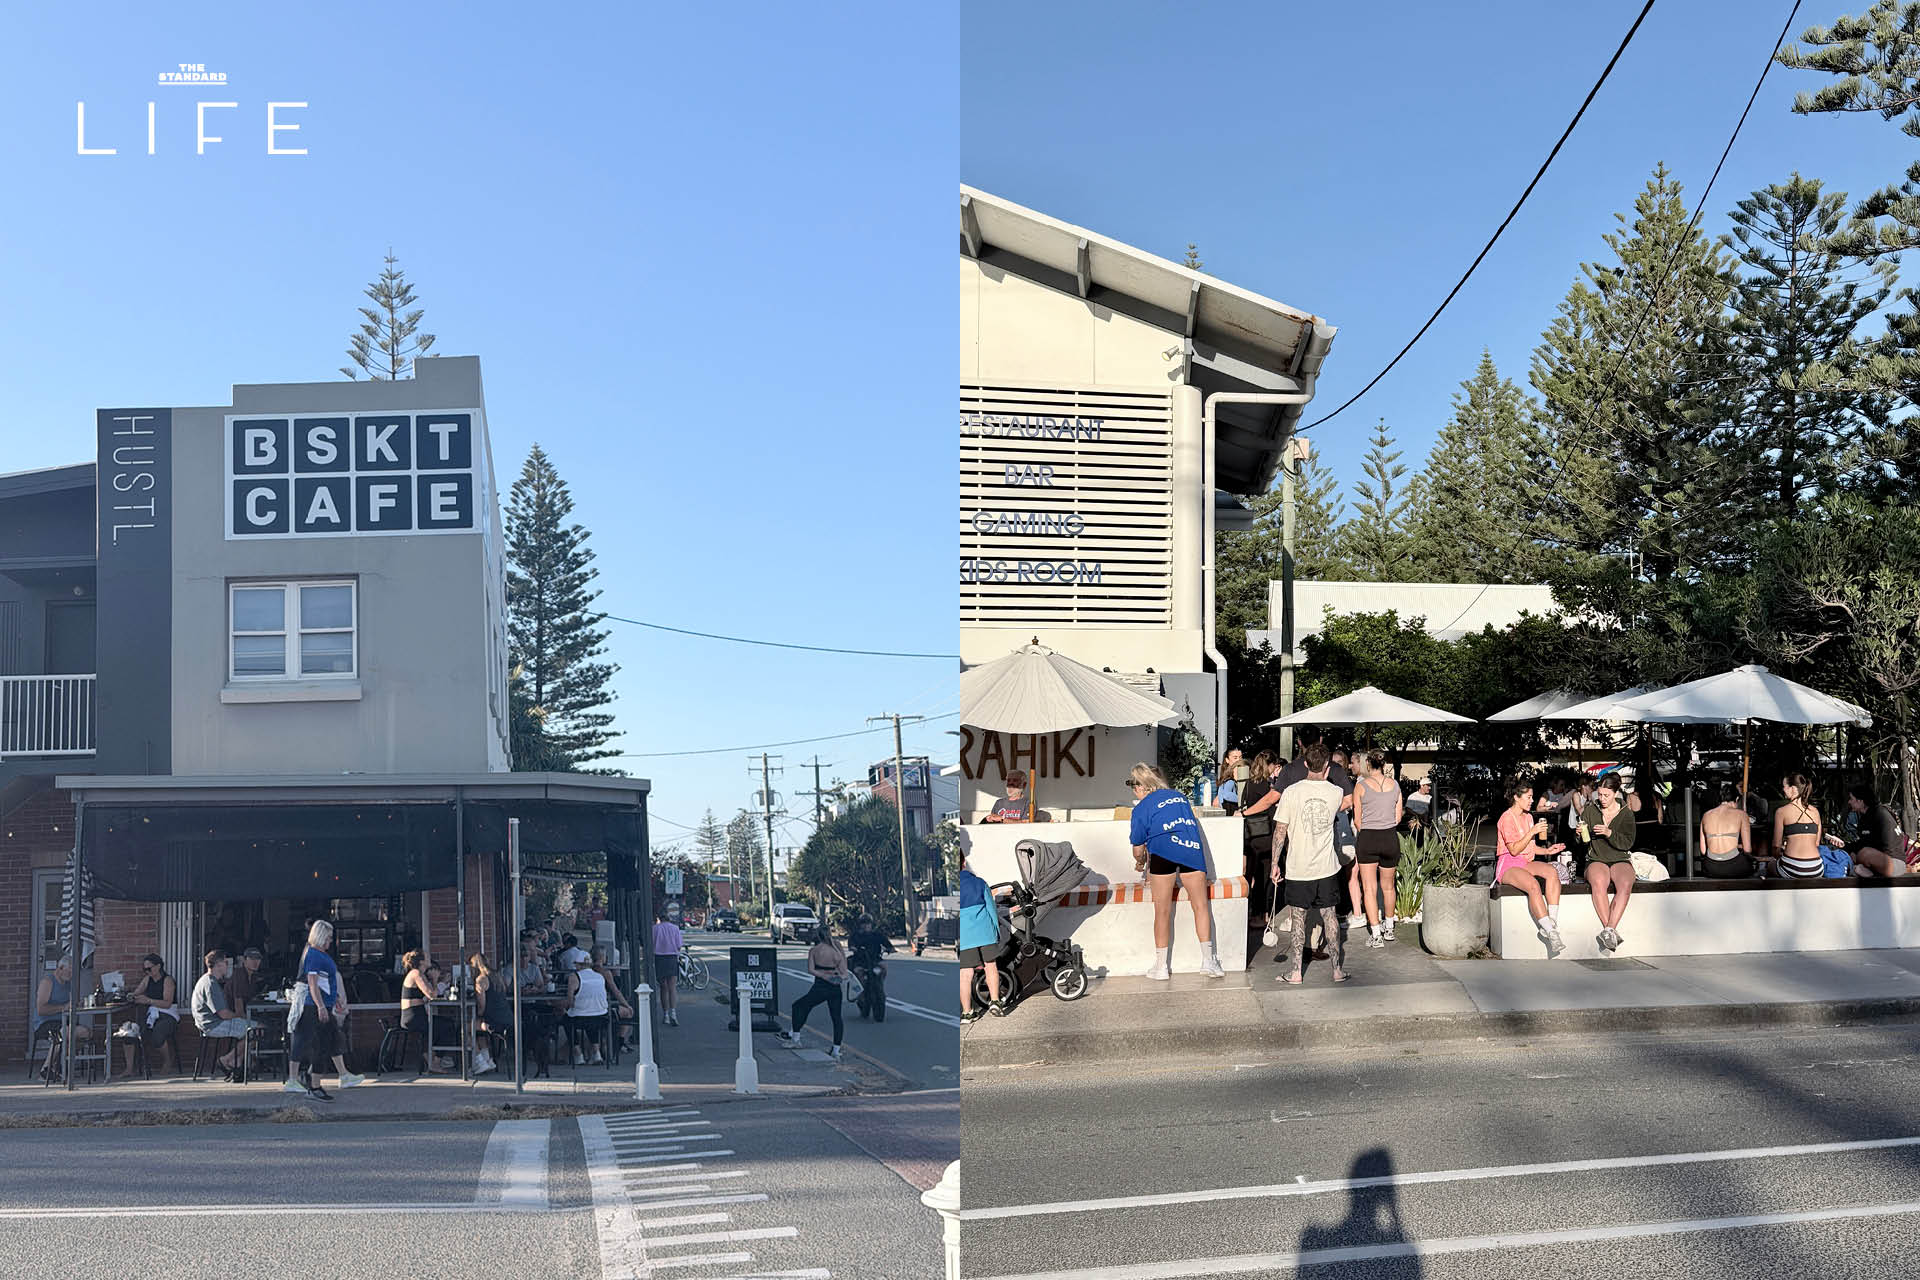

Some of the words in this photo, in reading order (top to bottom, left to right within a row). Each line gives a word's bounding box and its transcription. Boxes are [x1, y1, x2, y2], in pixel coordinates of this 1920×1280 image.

[244, 423, 459, 466] BSKT
[1004, 463, 1055, 487] BAR
[245, 482, 460, 527] CAFE
[971, 511, 1085, 537] GAMING
[1017, 561, 1102, 585] ROOM
[1157, 796, 1188, 809] COOL
[1170, 834, 1200, 850] CLUB
[743, 972, 766, 981] TAKE
